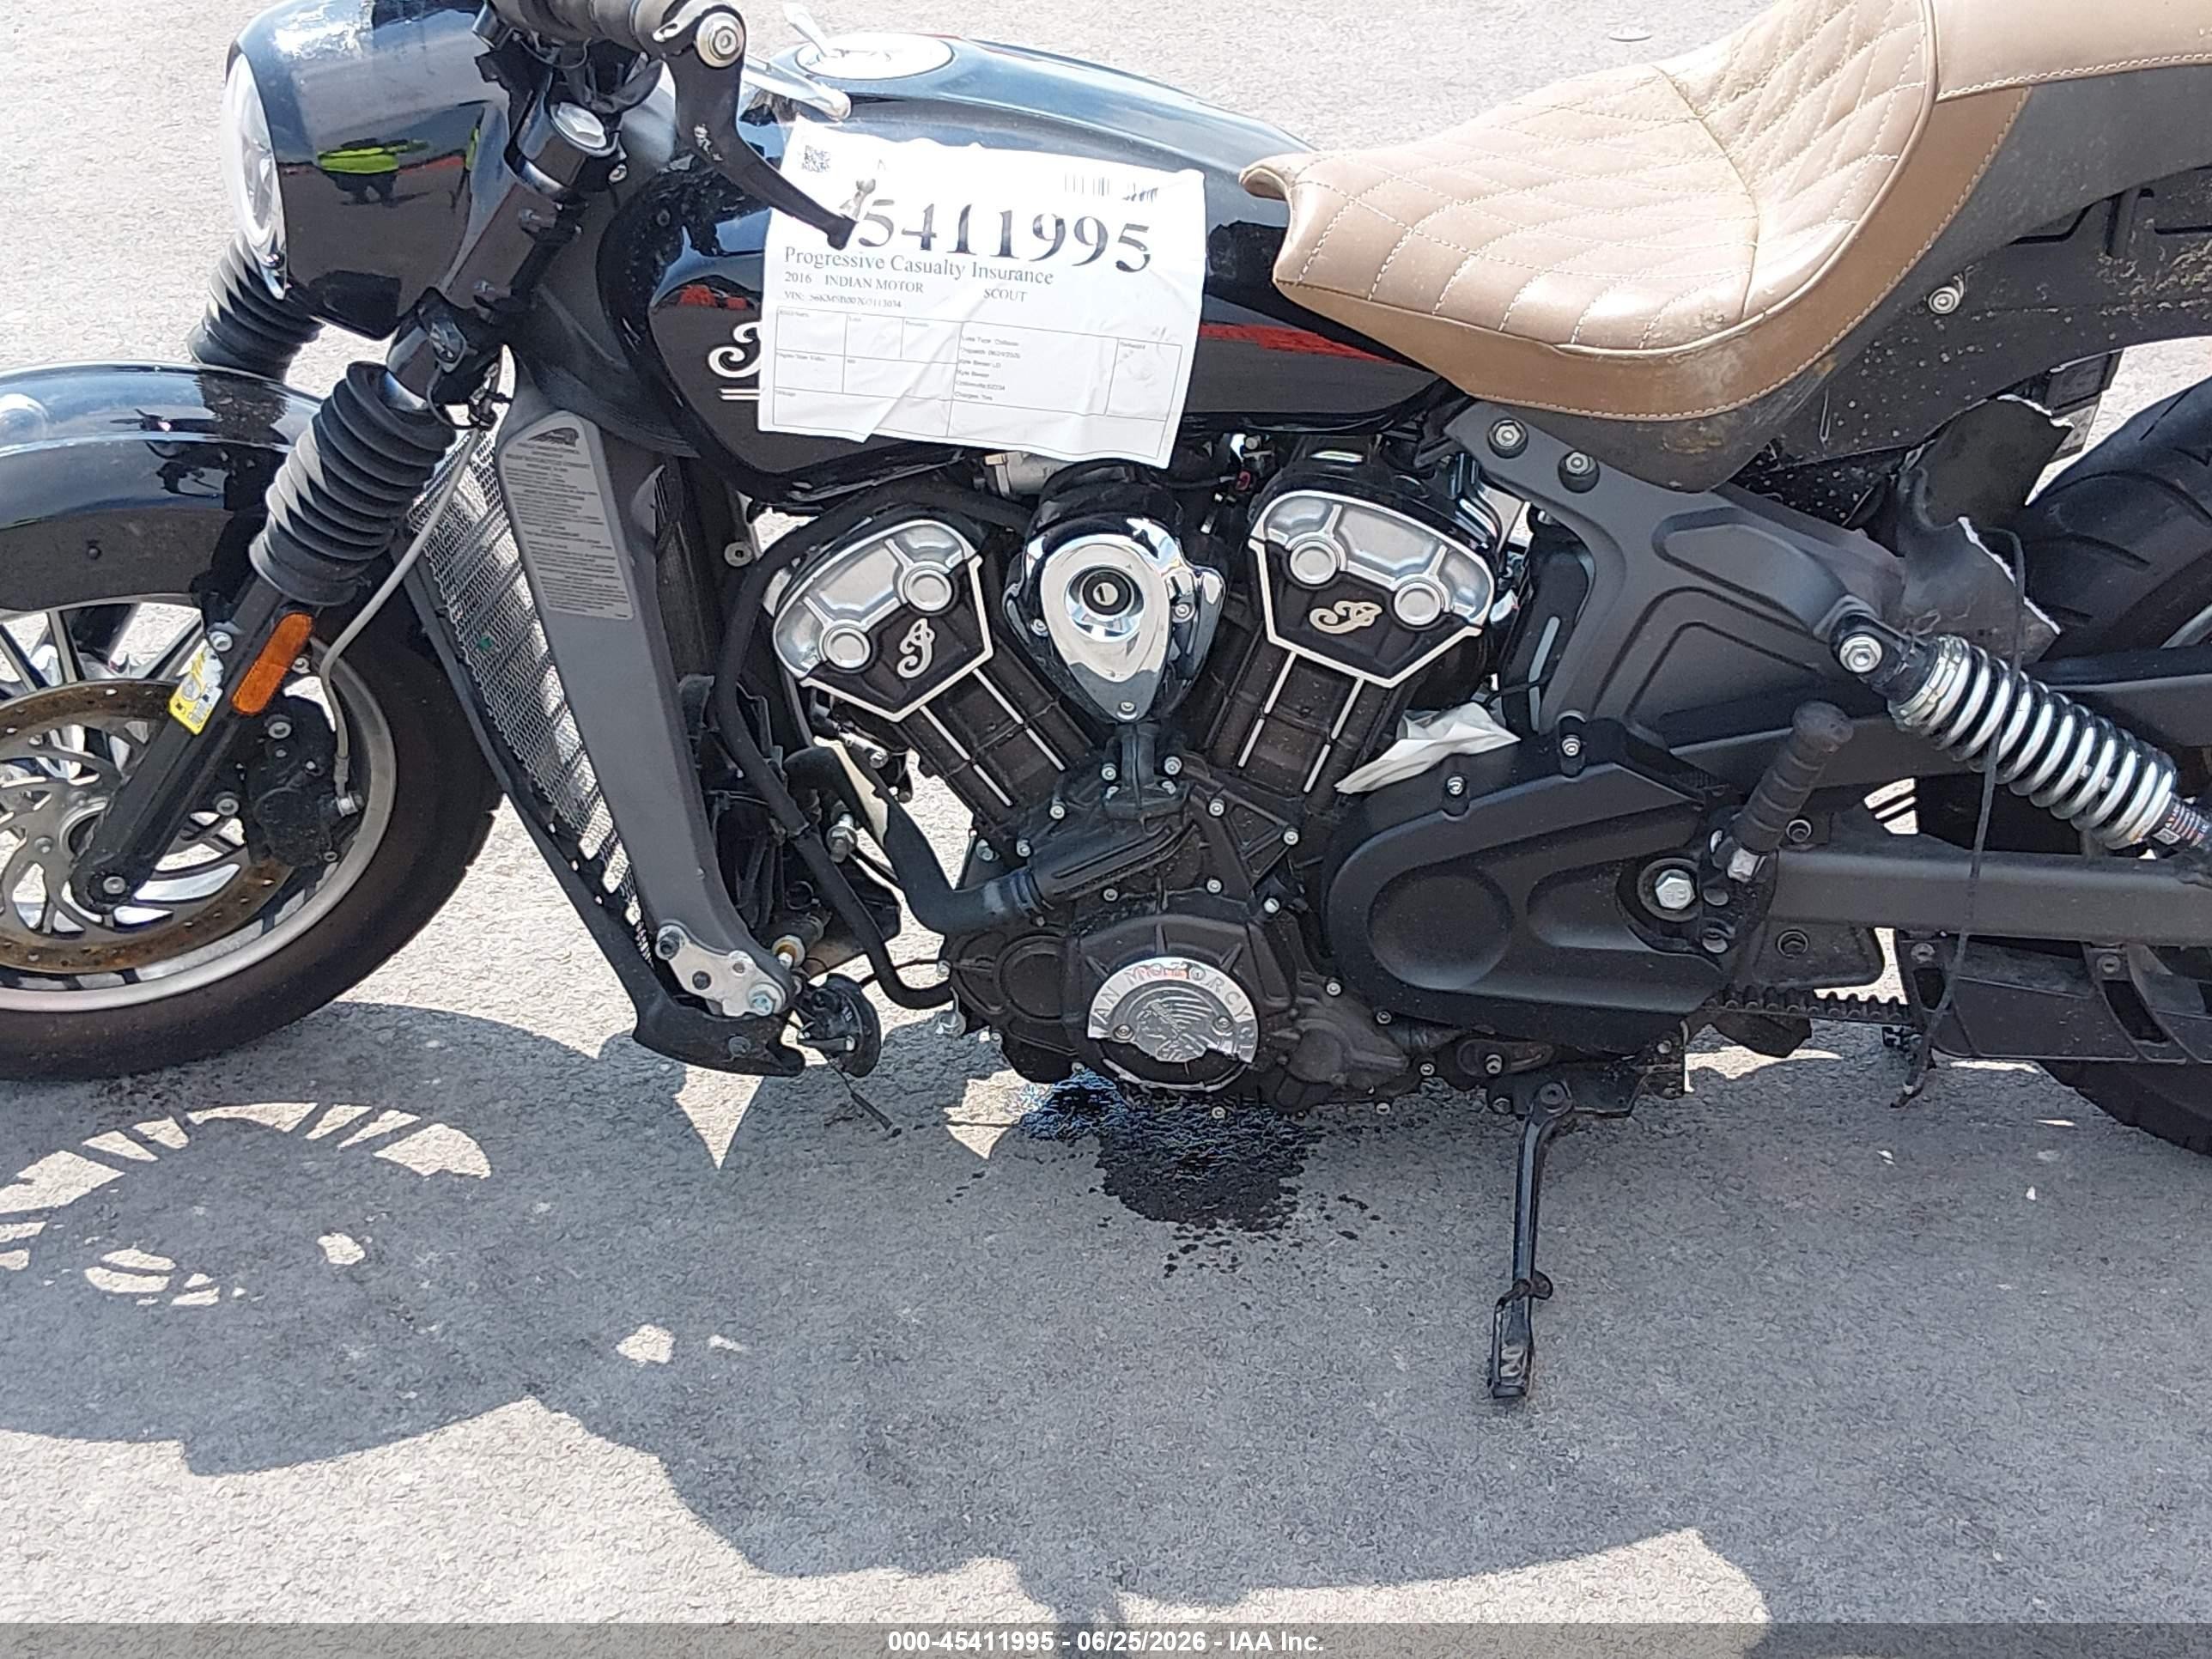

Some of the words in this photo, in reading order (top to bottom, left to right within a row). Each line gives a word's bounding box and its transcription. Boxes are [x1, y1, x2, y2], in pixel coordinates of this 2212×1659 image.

[785, 246, 885, 269] Progressive
[890, 254, 965, 280] Casualty
[972, 261, 1054, 284] Insurance
[785, 271, 812, 283] 2016
[825, 275, 872, 289] INDIAN
[876, 278, 924, 293] MOTOR
[983, 288, 1028, 302] SCOUT
